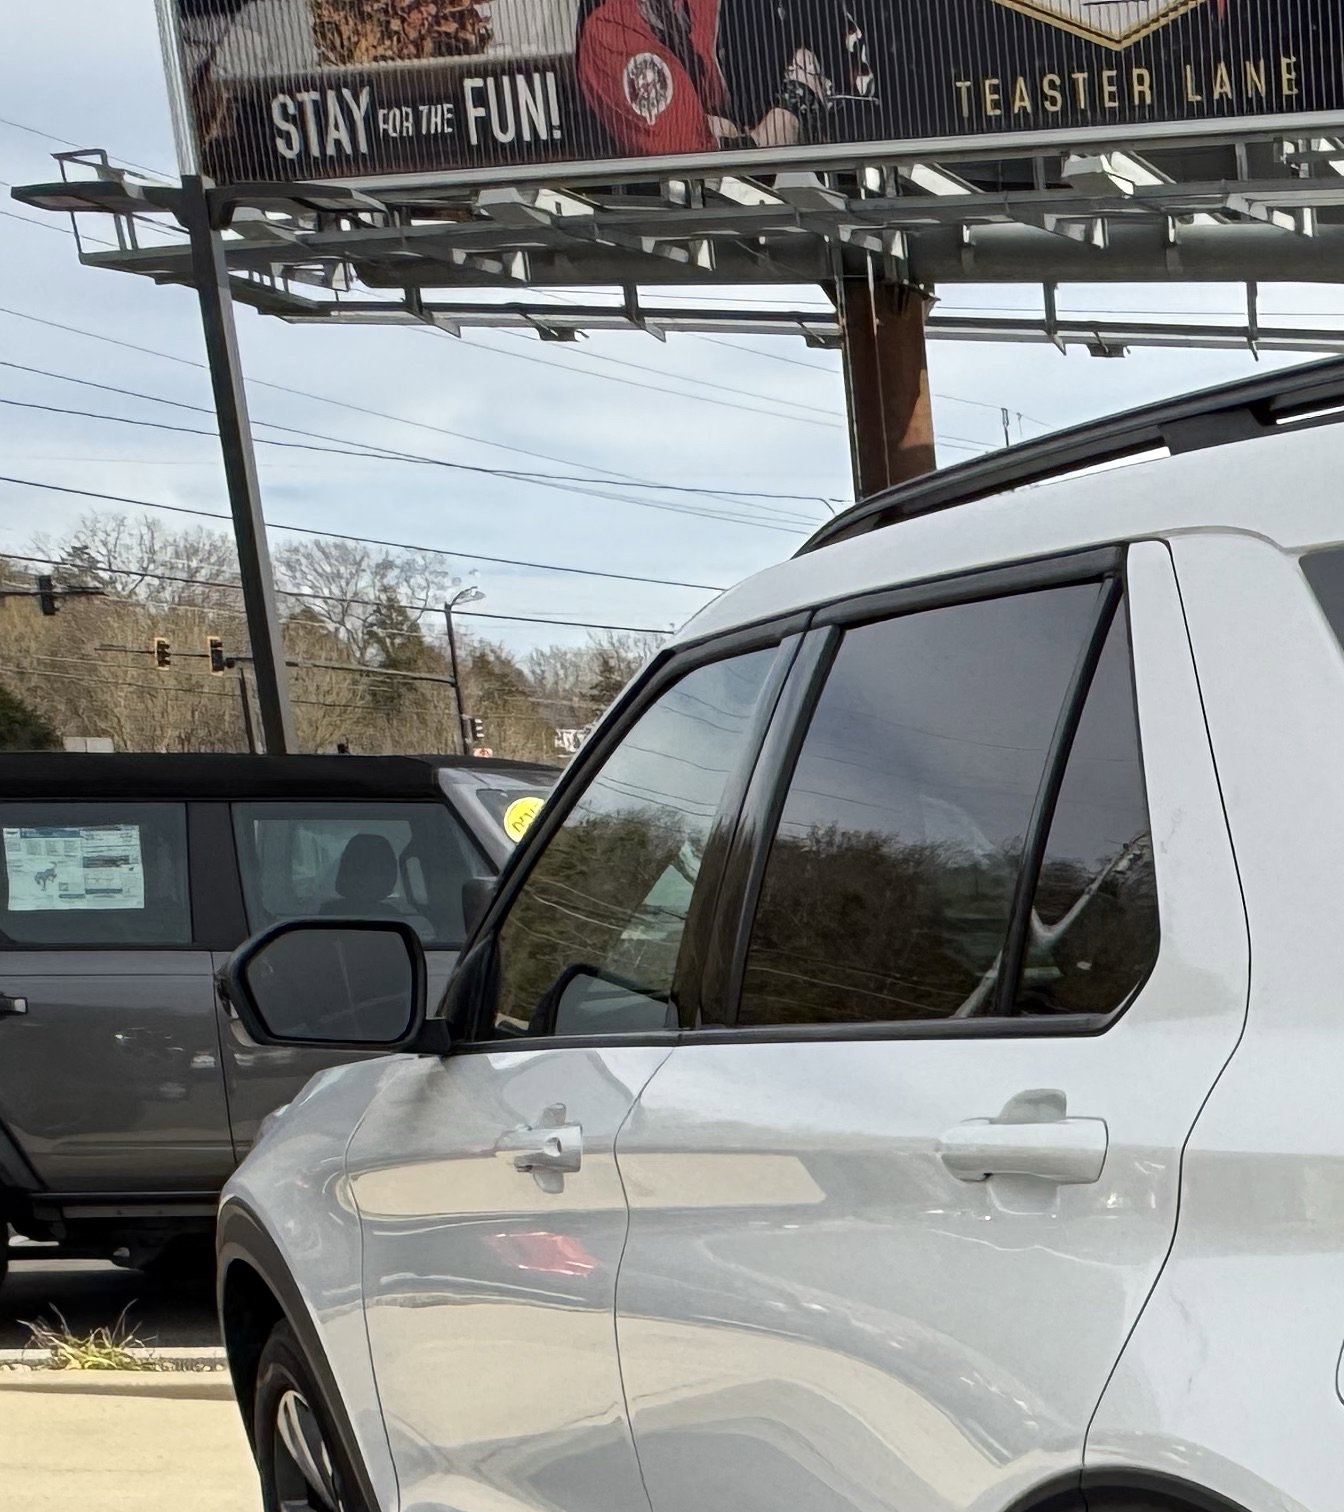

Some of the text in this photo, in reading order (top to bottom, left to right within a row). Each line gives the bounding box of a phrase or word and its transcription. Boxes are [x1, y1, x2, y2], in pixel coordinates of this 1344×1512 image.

[271, 86, 370, 160] STAY
[379, 106, 413, 137] FOR
[419, 103, 454, 134] THE
[464, 71, 562, 146] FUN!
[955, 54, 1299, 118] TEASTER LANE
